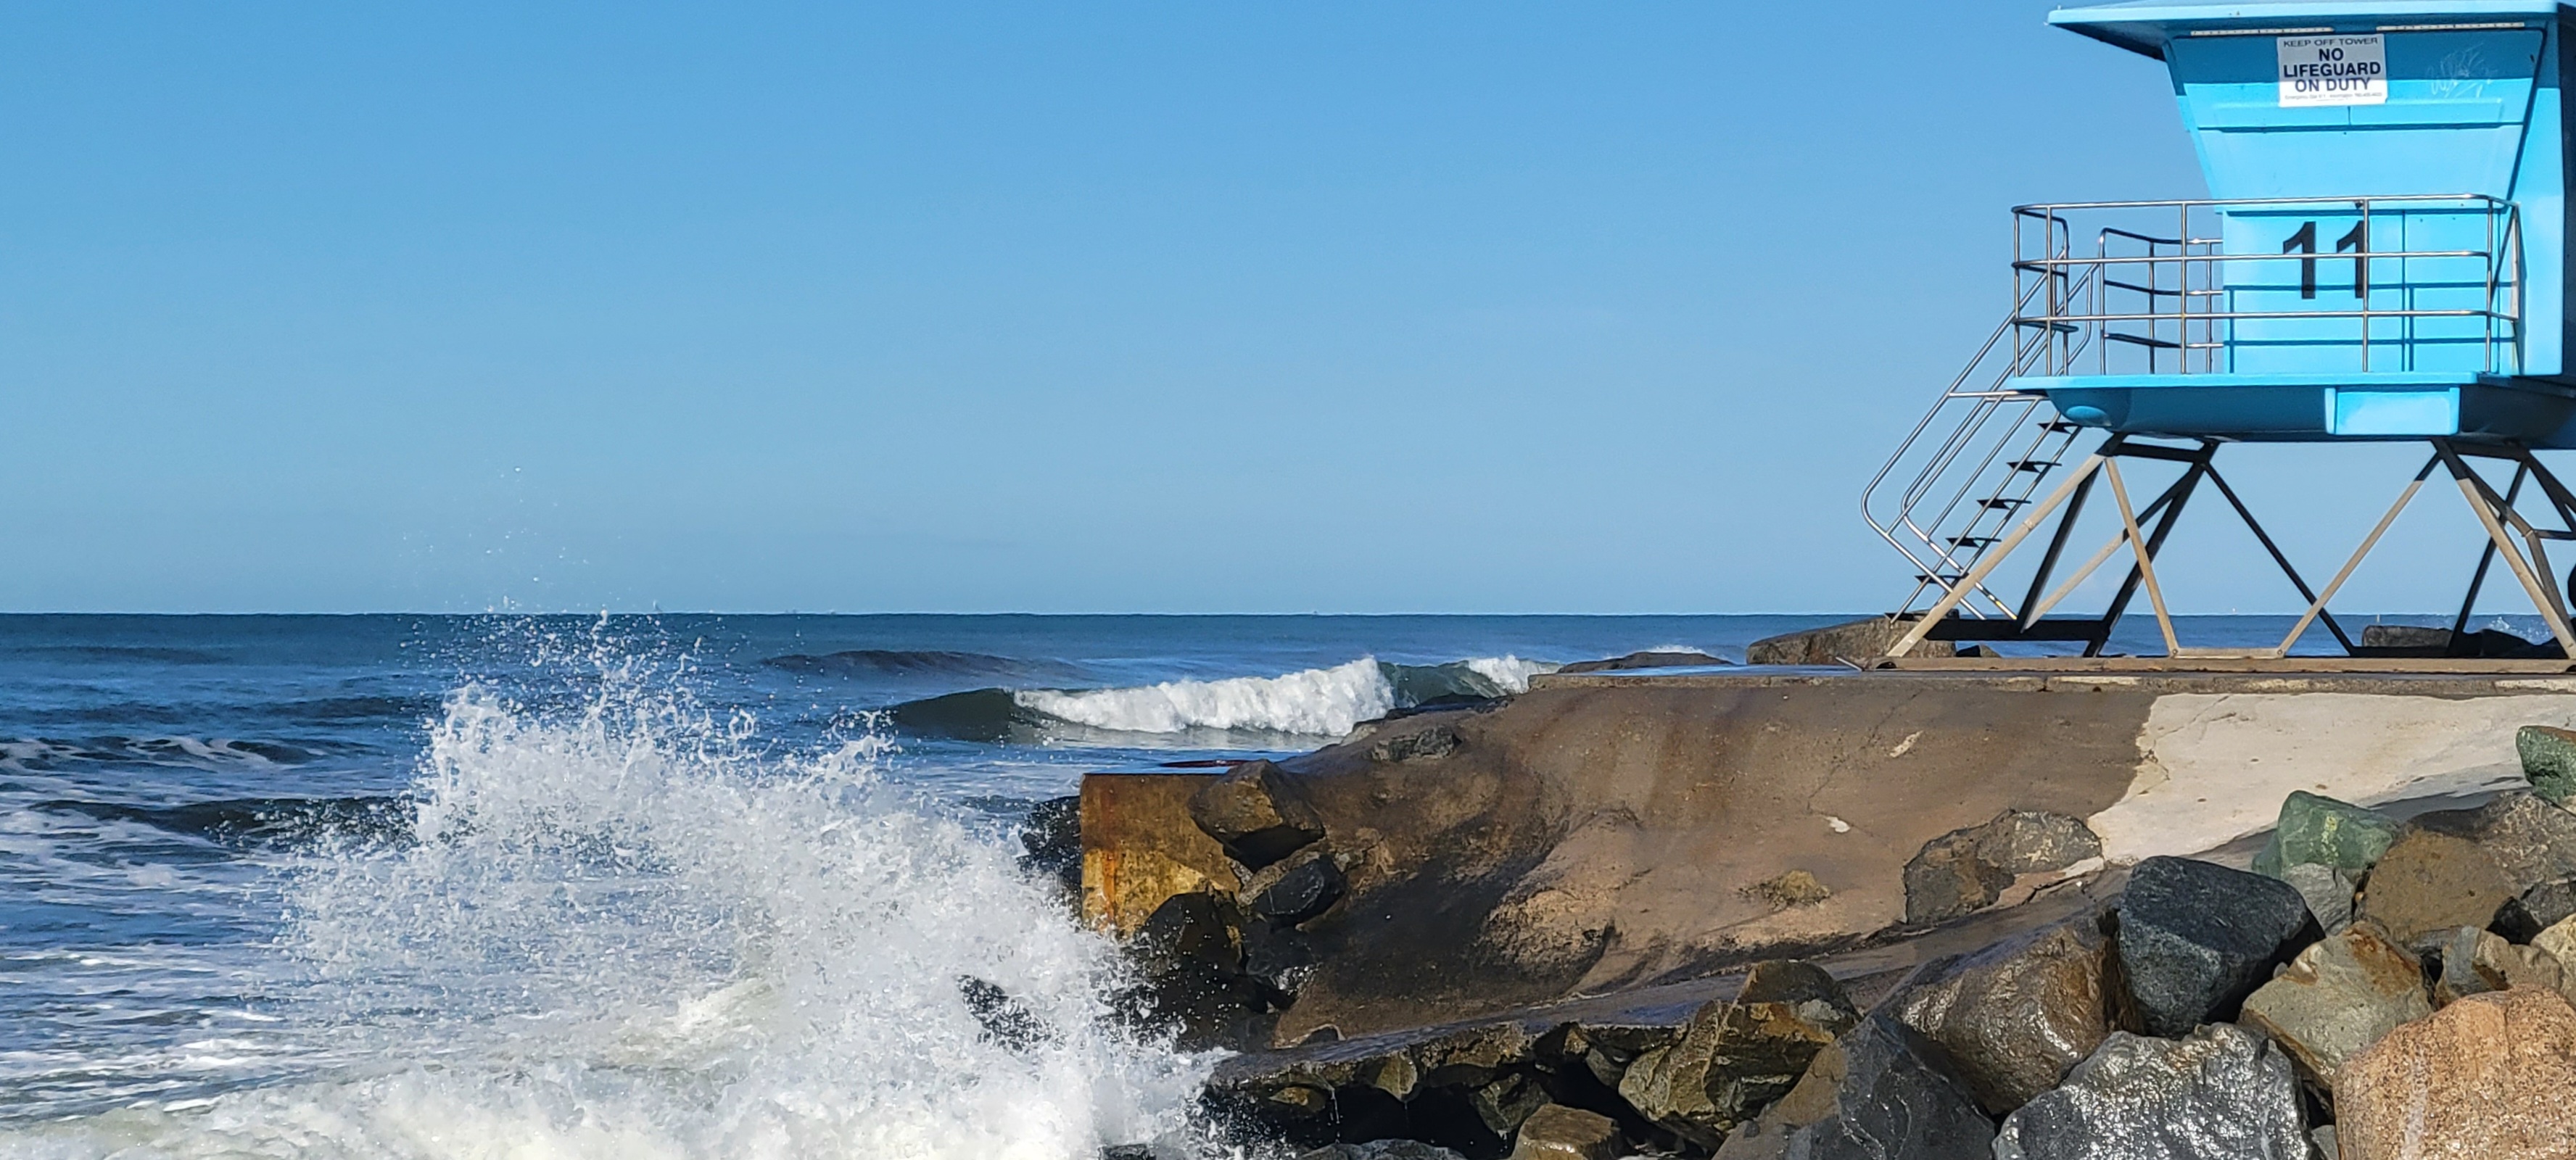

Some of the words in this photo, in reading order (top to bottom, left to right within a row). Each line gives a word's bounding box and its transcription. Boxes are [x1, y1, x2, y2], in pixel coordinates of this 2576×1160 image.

[2337, 37, 2379, 46] TOWER
[2319, 48, 2344, 61] NO
[2283, 62, 2382, 78] LIFEGUARD
[2295, 79, 2319, 92] ON
[2326, 77, 2371, 91] DUTY
[2283, 220, 2369, 299] 11
